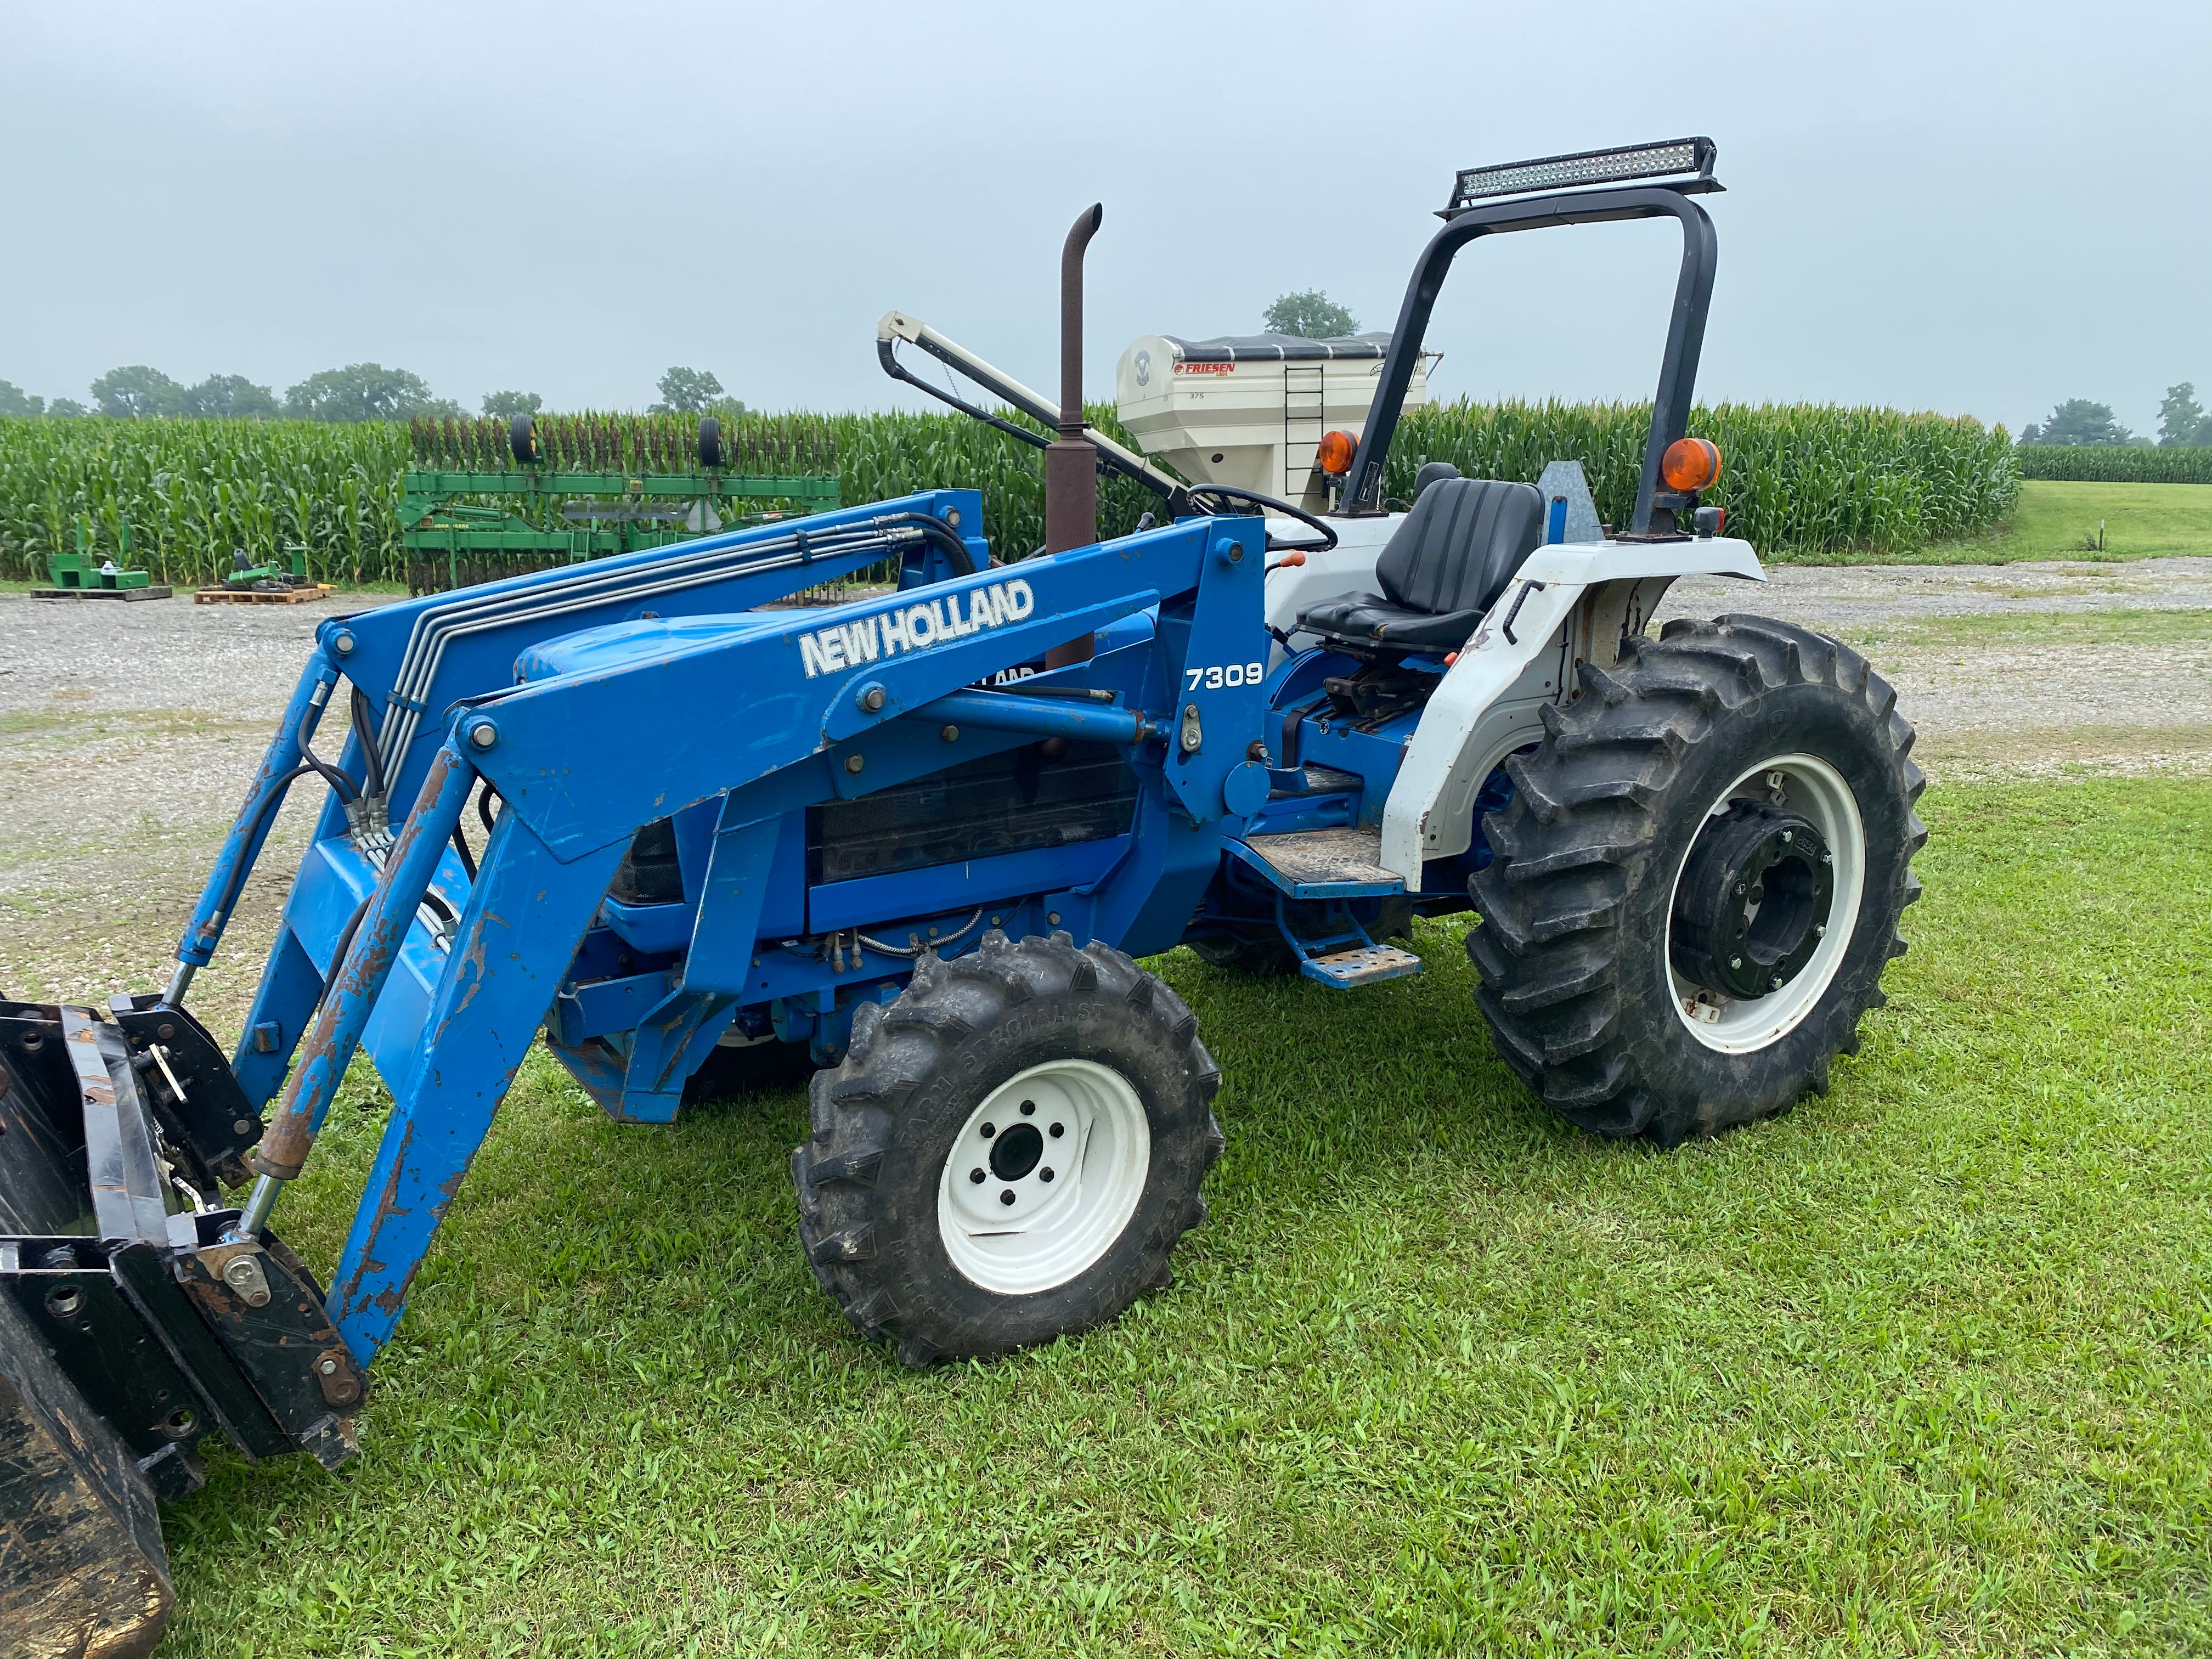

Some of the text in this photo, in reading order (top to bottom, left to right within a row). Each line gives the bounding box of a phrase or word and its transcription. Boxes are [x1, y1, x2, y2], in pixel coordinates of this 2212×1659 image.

[1186, 363, 1234, 373] FRIESEN
[798, 578, 1035, 679] NEW HOLLAND
[1186, 662, 1263, 692] 7309
